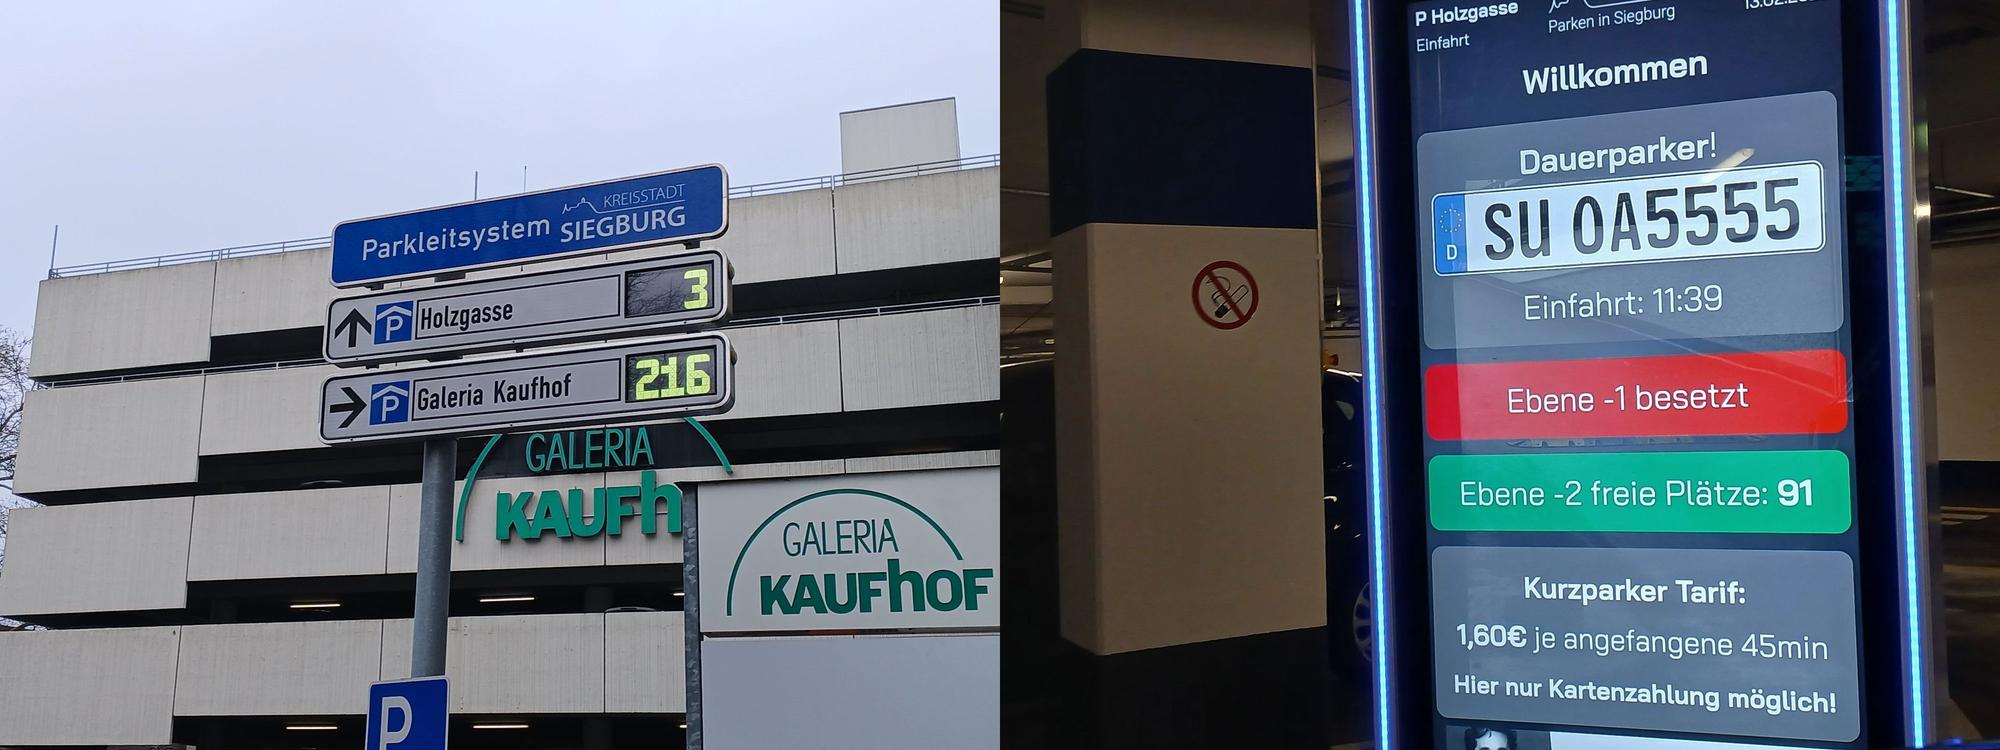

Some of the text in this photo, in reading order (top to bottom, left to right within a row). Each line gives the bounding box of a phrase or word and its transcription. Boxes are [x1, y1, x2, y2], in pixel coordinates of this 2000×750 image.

[1415, 2, 1519, 26] P Holzgasse
[1548, 6, 1676, 33] Parken in Siegburg
[1416, 33, 1470, 52] Einfahrt
[1523, 55, 1708, 95] Willkommen
[1519, 132, 1717, 176] Dauerparker!
[604, 184, 686, 208] KREISSTADT
[362, 218, 550, 262] Parkleitsystem
[560, 206, 686, 242] SIEGBURG
[1484, 197, 1551, 261] SU
[1446, 243, 1458, 262] D
[420, 303, 513, 332] Holzgasse
[684, 269, 708, 309] 3
[1524, 284, 1724, 321] Einfahrt: 11:39
[418, 386, 483, 411] Galeria
[494, 373, 571, 404] Kaufhof
[635, 354, 711, 401] 216
[1507, 382, 1749, 414] Ebene -1 besetzt
[525, 427, 655, 473] GALERIA
[496, 470, 683, 542] KAUFh
[1460, 479, 1813, 508] Ebene -2 freie Plätze: 91
[783, 518, 899, 557] GALERIA
[761, 559, 994, 616] KAUFhOF
[1523, 576, 1746, 607] Kurzparker Tarif:
[1456, 623, 1829, 660] 1,60€ je angefangene 45min
[1454, 675, 1836, 714] Hier nur Kartenzahlung möglich!
[379, 696, 413, 750] P
